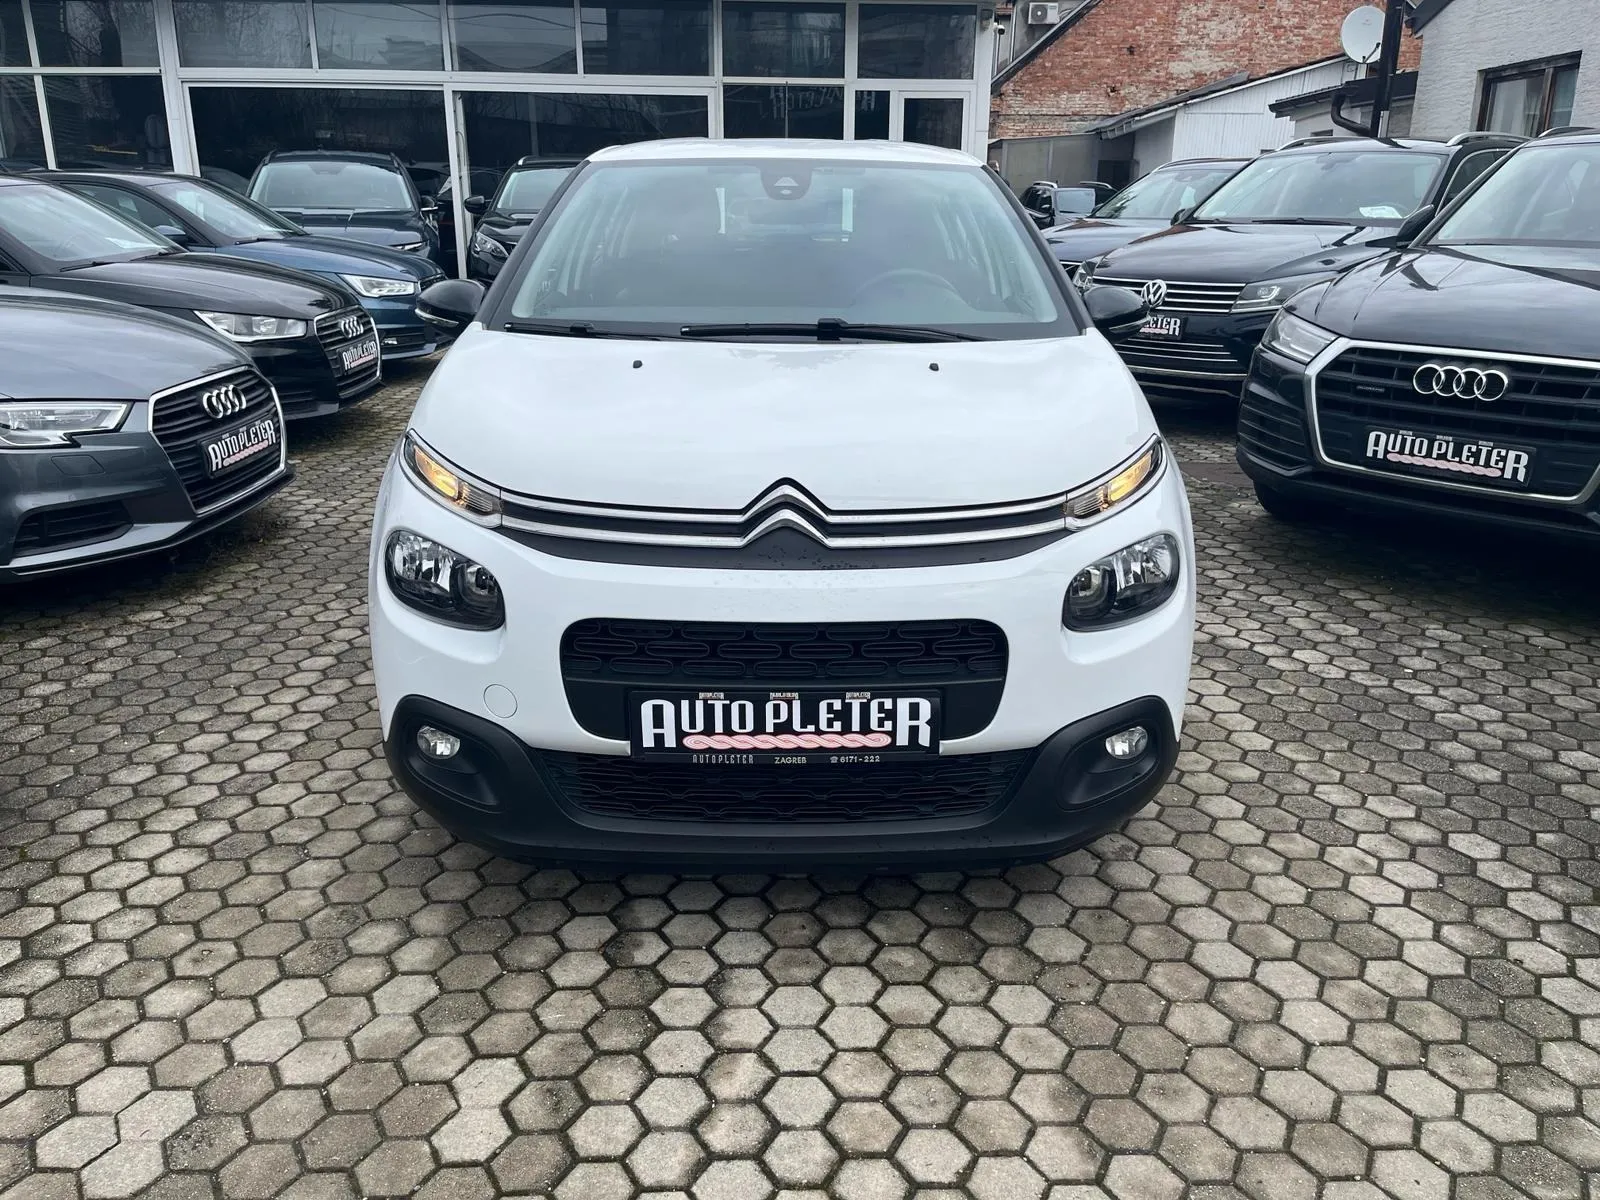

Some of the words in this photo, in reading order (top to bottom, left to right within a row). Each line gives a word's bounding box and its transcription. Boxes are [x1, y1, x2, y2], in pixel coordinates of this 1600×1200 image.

[1366, 430, 1427, 459] AUTO
[1432, 440, 1529, 483] PLETER
[640, 698, 754, 748] AUTO
[765, 697, 931, 747] PLETER
[774, 756, 807, 764] ZAGREB
